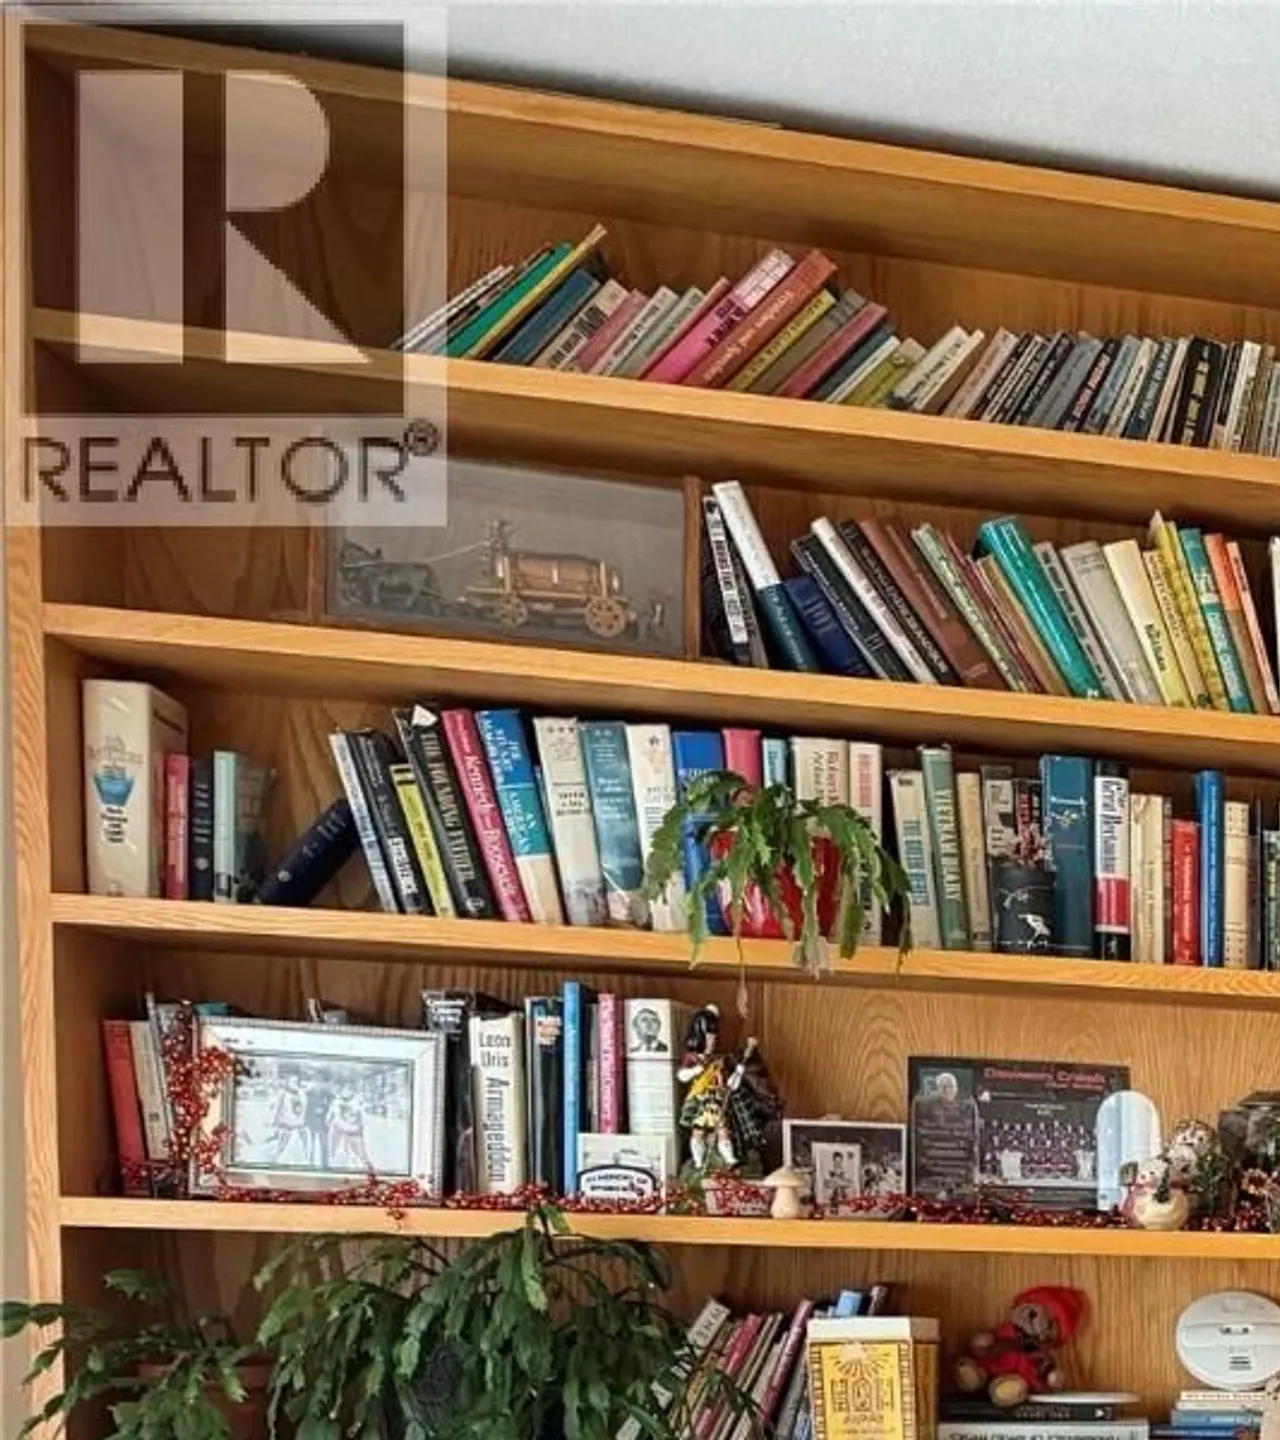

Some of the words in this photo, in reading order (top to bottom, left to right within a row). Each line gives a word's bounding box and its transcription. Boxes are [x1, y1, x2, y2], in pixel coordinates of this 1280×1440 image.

[934, 788, 956, 854] VIETNAM
[480, 1032, 511, 1047] Leon
[480, 1052, 509, 1068] Uris
[483, 1078, 510, 1182] Armageddon
